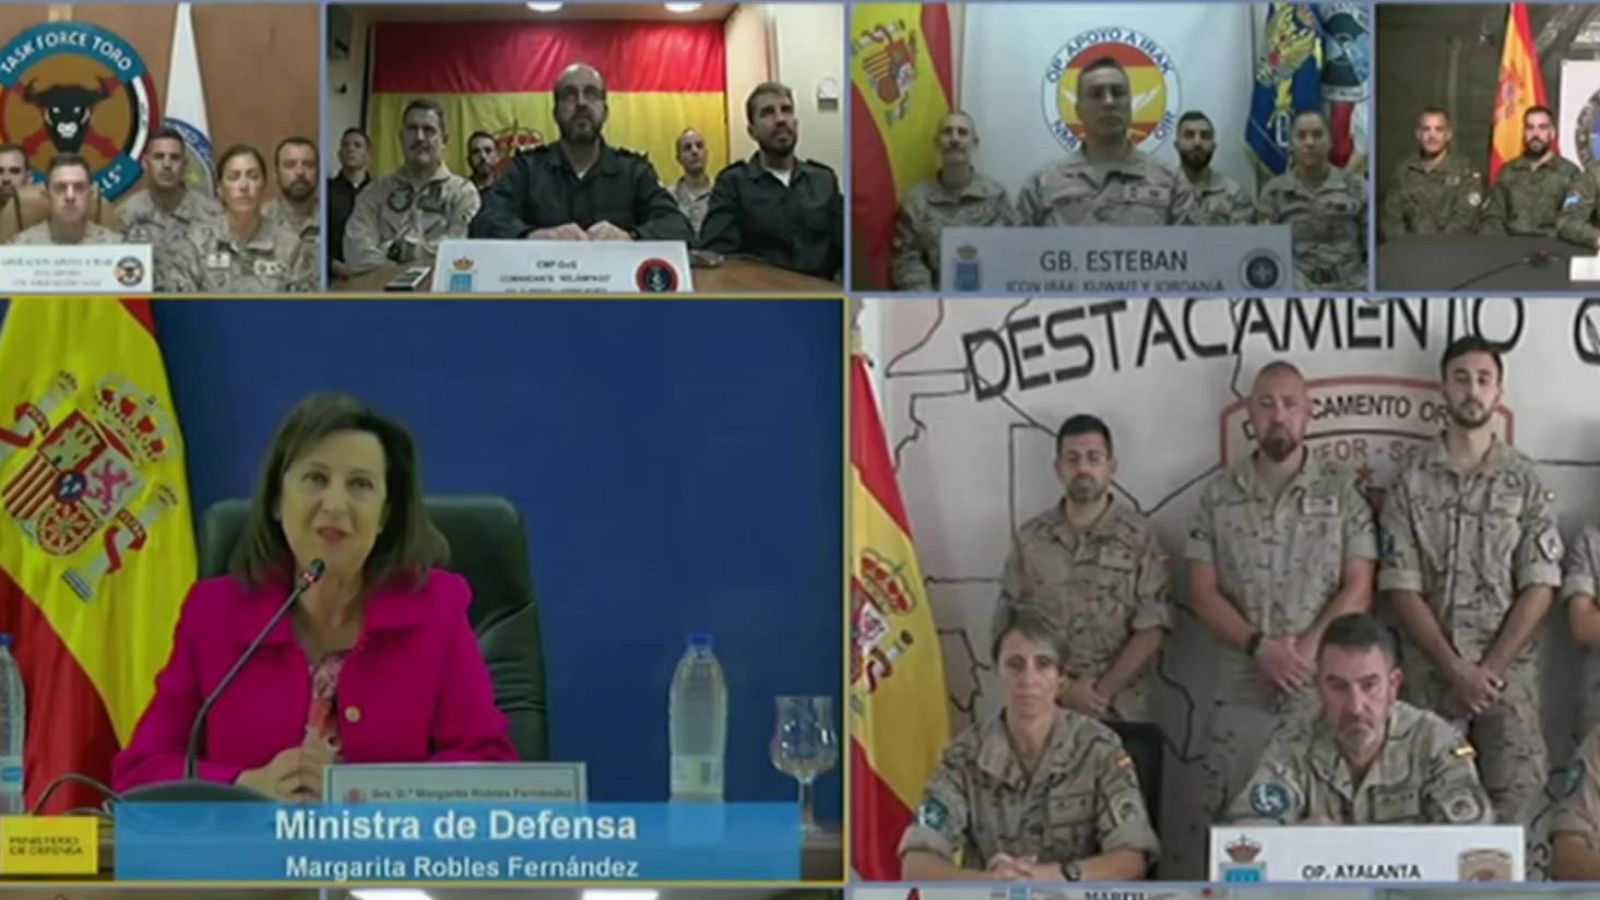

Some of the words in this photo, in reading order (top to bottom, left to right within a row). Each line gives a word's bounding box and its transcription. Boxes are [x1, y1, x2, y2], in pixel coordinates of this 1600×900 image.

[1066, 28, 1121, 56] APOYO
[1125, 32, 1137, 44] A
[0, 40, 35, 73] TASK
[35, 31, 88, 50] FORCE
[92, 35, 132, 71] TORO
[1040, 250, 1078, 271] GB.
[1086, 250, 1188, 271] ESTEBAN
[1141, 280, 1150, 291] Y
[961, 298, 1524, 402] DESTACAMENTO
[416, 788, 468, 800] Margarita
[471, 788, 510, 798] Robles
[9, 837, 80, 845] MINISTERIO
[9, 847, 26, 855] DE
[29, 847, 84, 855] DEFENSA
[1302, 864, 1331, 880] OP.
[1335, 864, 1421, 880] ATALANTA
